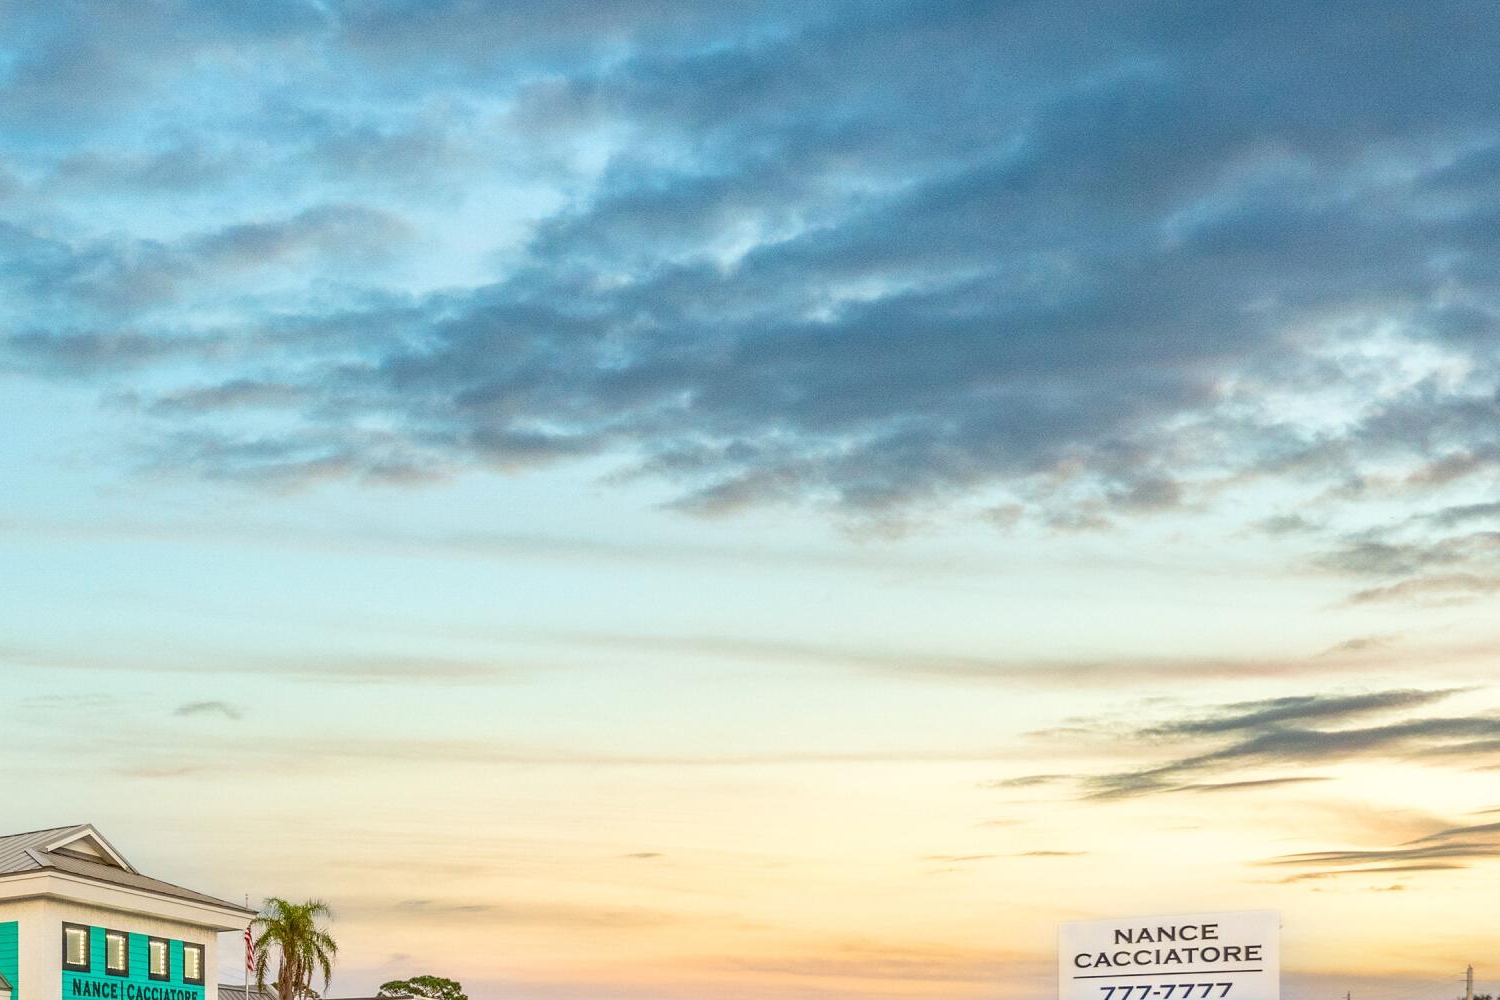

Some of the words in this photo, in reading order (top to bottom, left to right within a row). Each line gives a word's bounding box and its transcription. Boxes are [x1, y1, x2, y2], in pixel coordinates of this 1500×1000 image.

[1114, 923, 1219, 945] NANCE
[1073, 944, 1263, 969] CACCIATORE
[72, 978, 118, 999] NANCE
